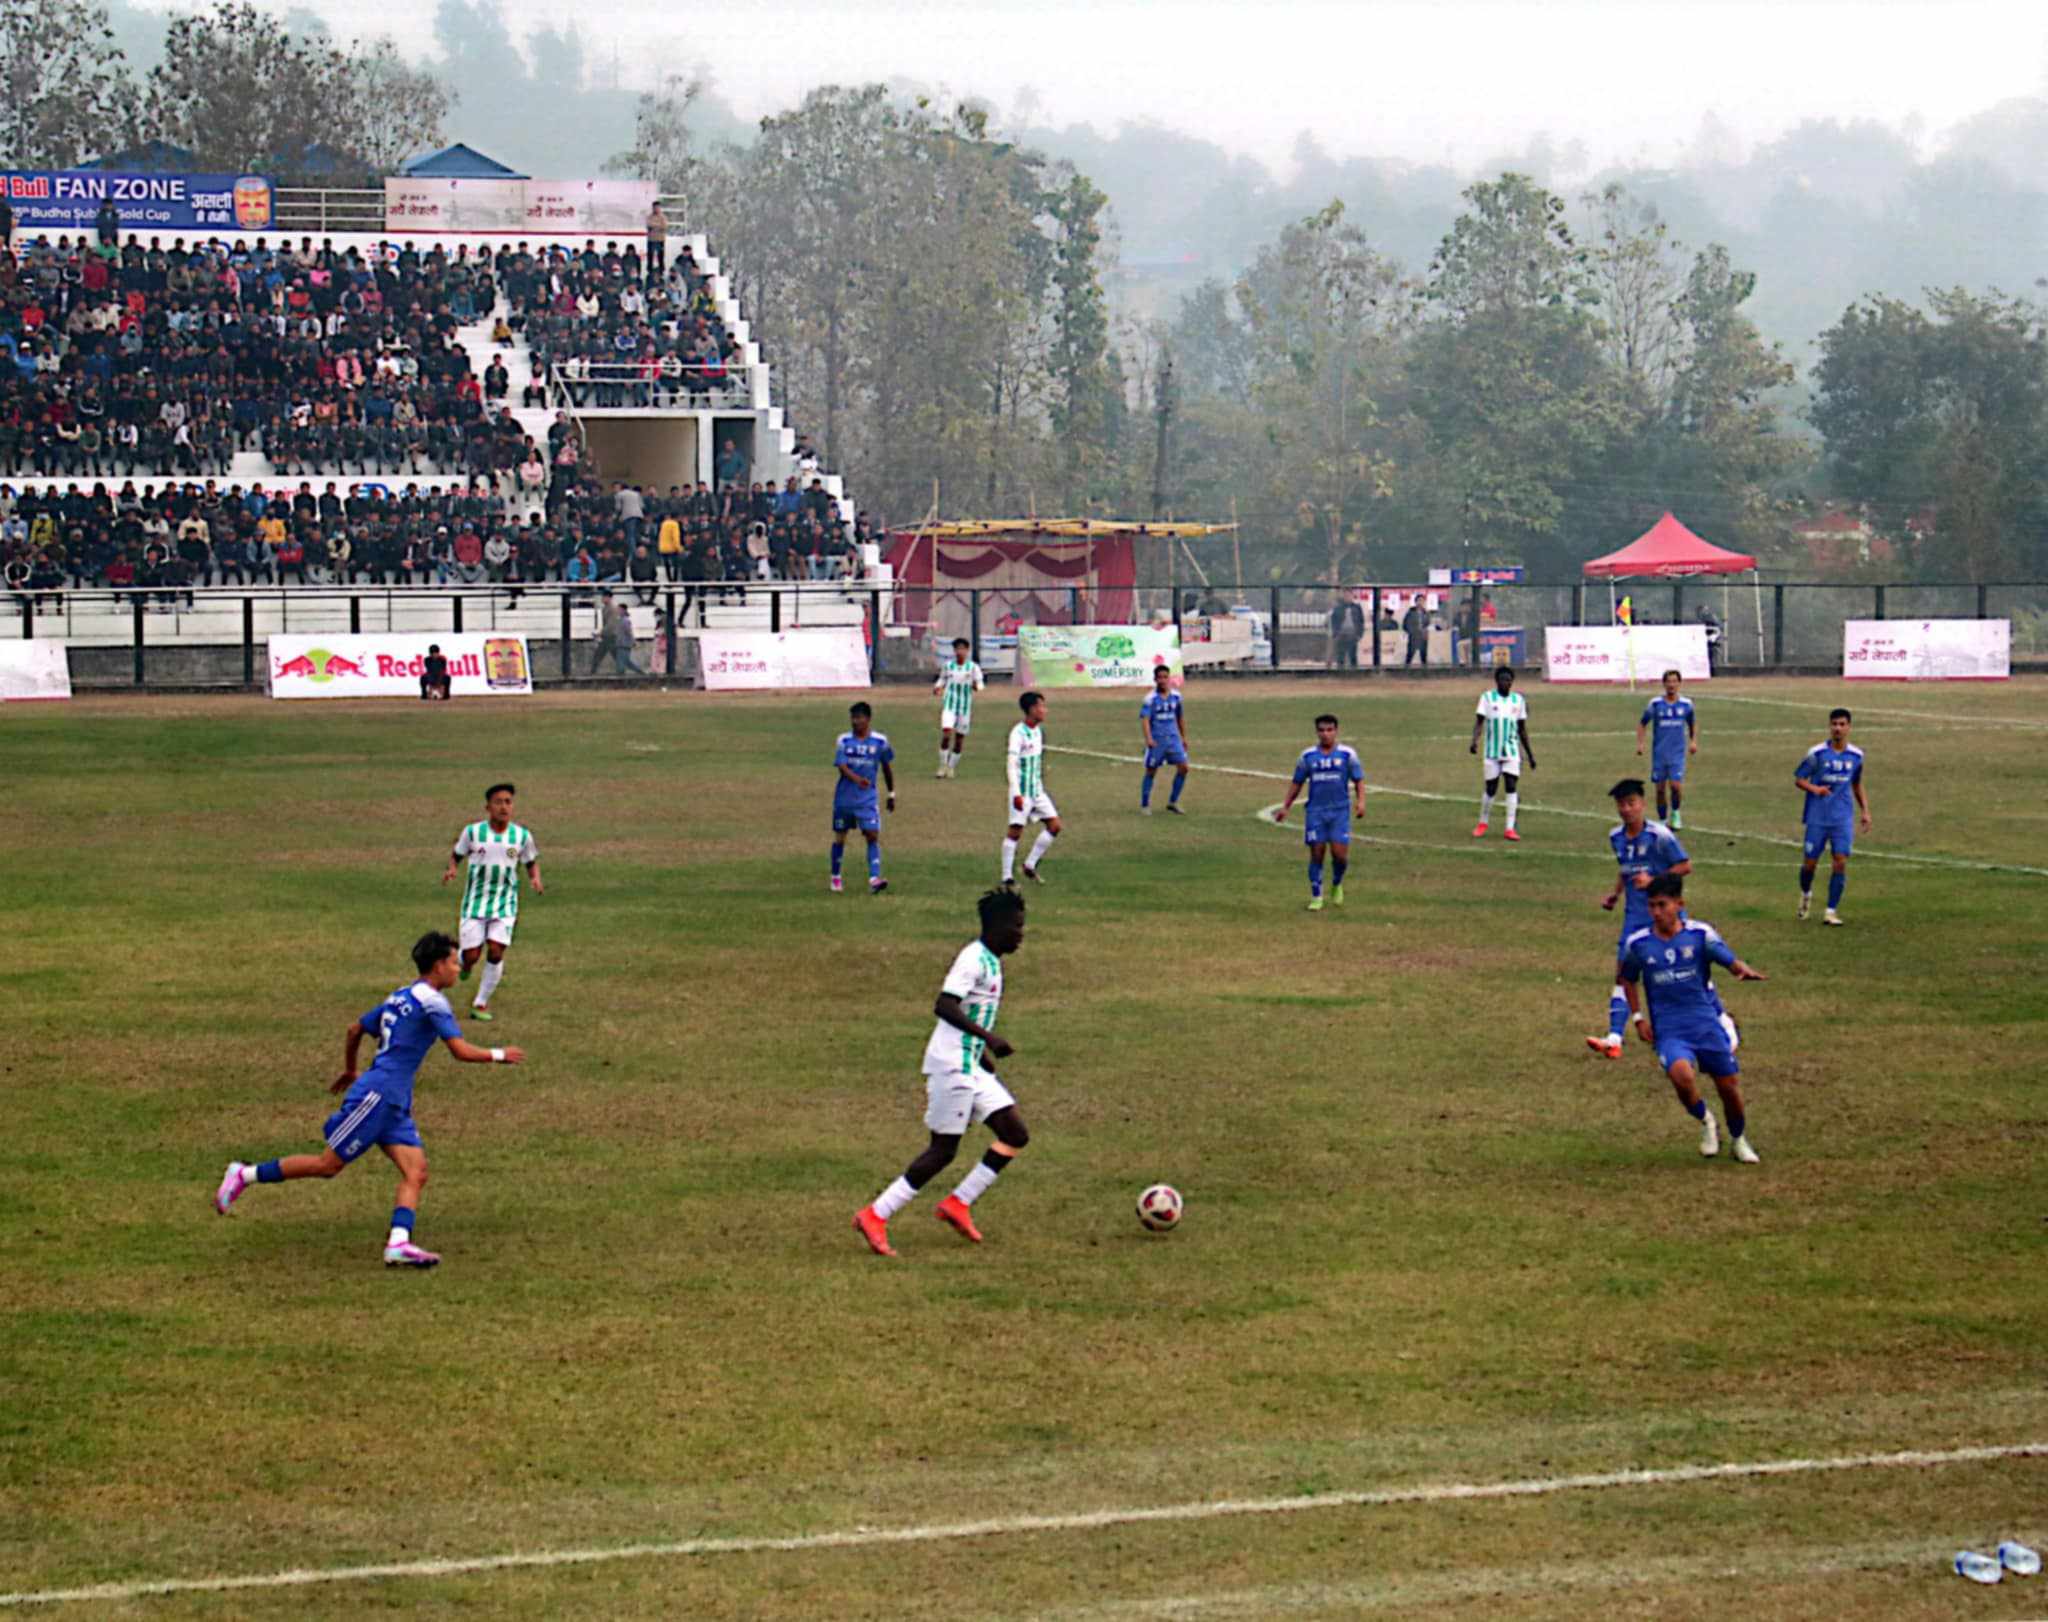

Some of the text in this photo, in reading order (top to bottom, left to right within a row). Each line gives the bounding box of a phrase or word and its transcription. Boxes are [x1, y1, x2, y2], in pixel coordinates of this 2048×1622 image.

[11, 176, 48, 198] Bull
[56, 178, 106, 199] FAN
[113, 179, 185, 200] ZONE
[32, 207, 71, 219] Budha
[145, 208, 171, 222] Cup
[376, 654, 424, 677] Red
[1664, 948, 1676, 965] 9
[377, 1012, 397, 1054] 5
